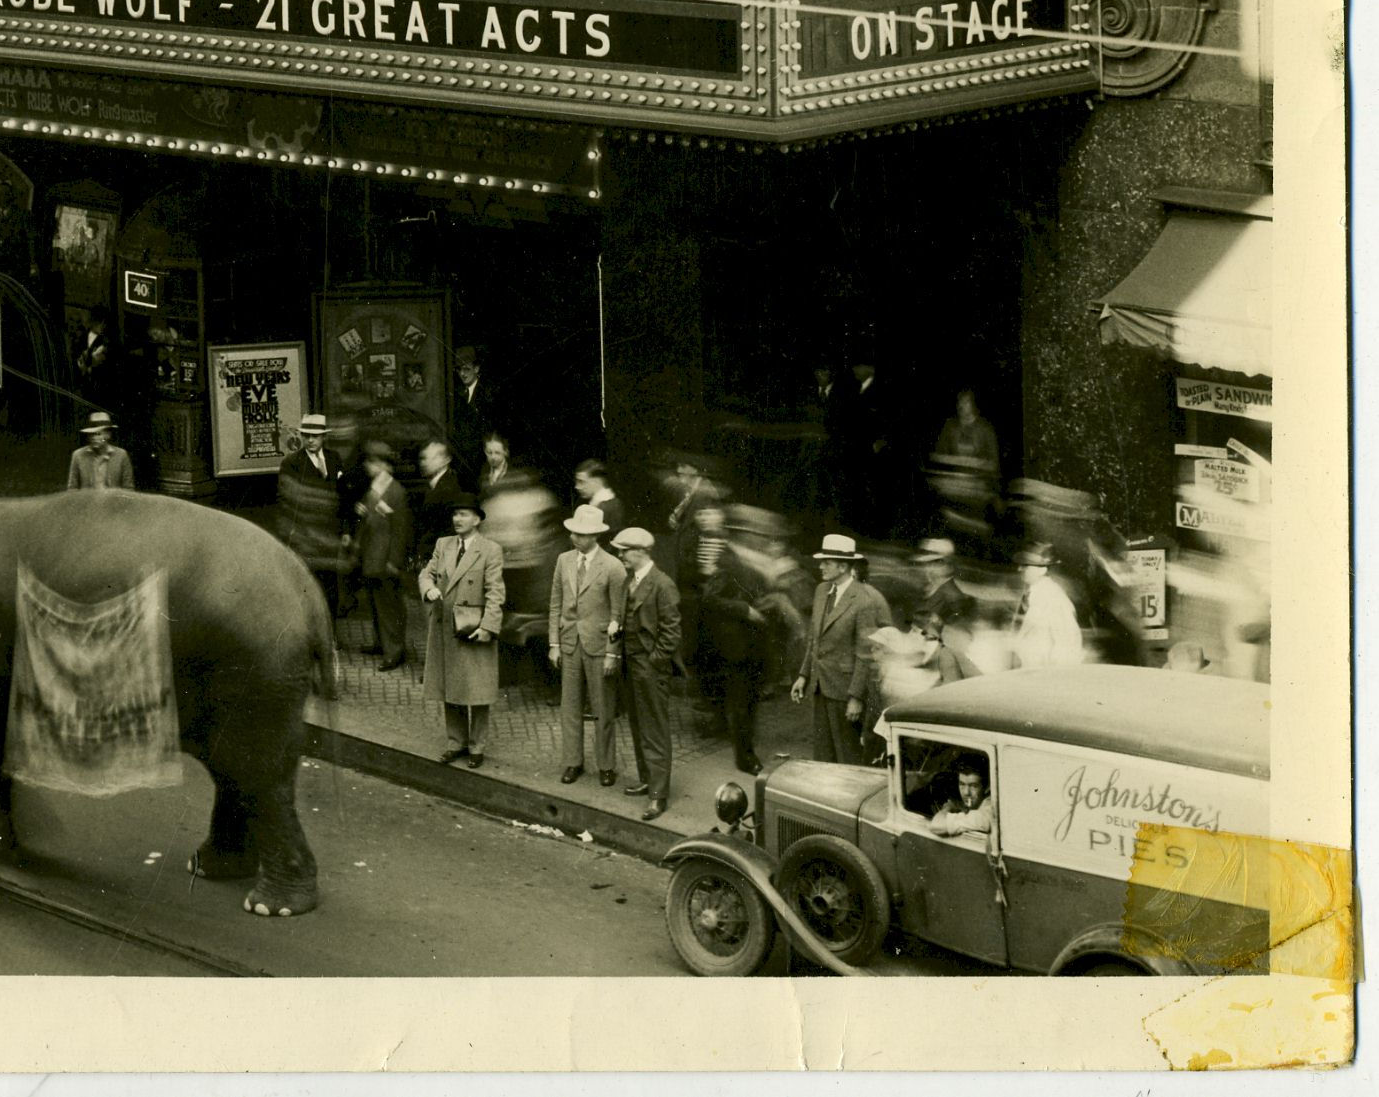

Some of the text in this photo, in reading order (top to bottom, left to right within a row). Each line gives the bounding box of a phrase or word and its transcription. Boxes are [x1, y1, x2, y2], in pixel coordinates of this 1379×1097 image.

[481, 6, 611, 58] ACTS
[851, 11, 897, 60] ON
[27, 91, 53, 112] RUBE
[56, 95, 92, 116] WOLF
[97, 99, 157, 124] Ringmaster
[226, 373, 253, 387] NEW
[241, 385, 277, 403] EVE
[1180, 384, 1209, 397] TOASTED
[1192, 393, 1212, 405] PLAIN
[243, 412, 278, 423] FROLIC
[1205, 464, 1245, 475] MALTED MILK
[1054, 765, 1221, 842] Johnston's
[1089, 829, 1189, 868] PIES
